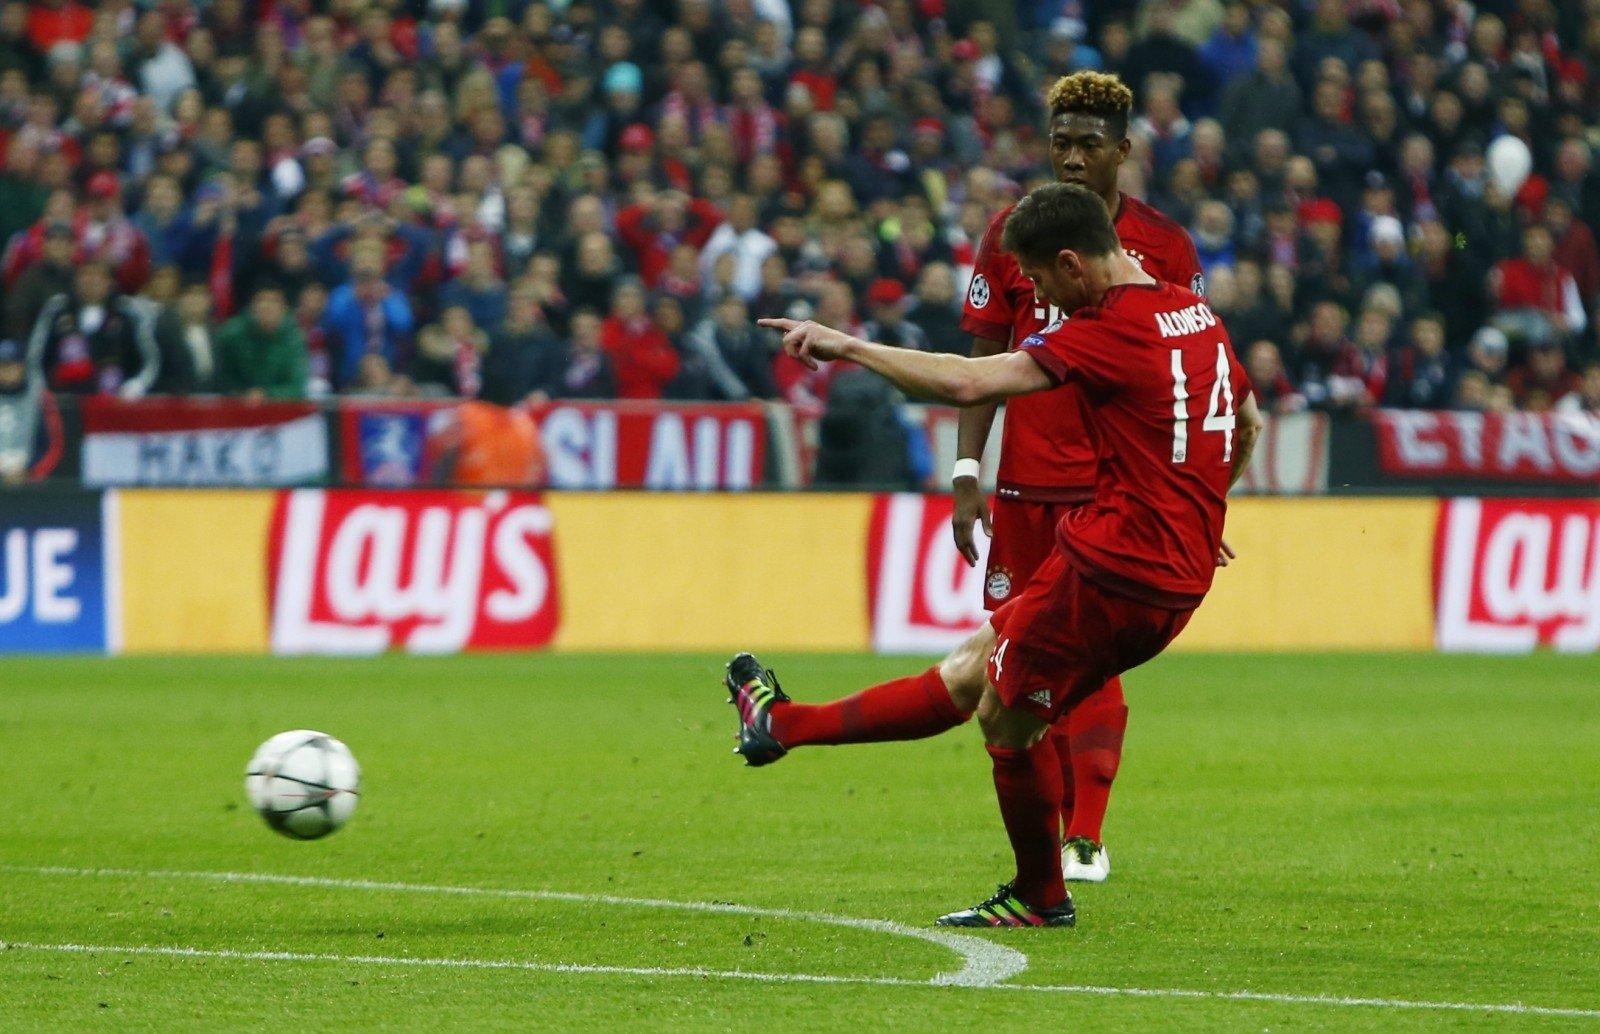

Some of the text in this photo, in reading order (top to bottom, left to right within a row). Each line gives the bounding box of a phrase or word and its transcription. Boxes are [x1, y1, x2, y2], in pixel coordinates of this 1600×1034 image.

[1155, 302, 1216, 338] ALONSO
[1171, 342, 1236, 464] 14
[271, 488, 554, 654] Lay's
[873, 492, 994, 654] La
